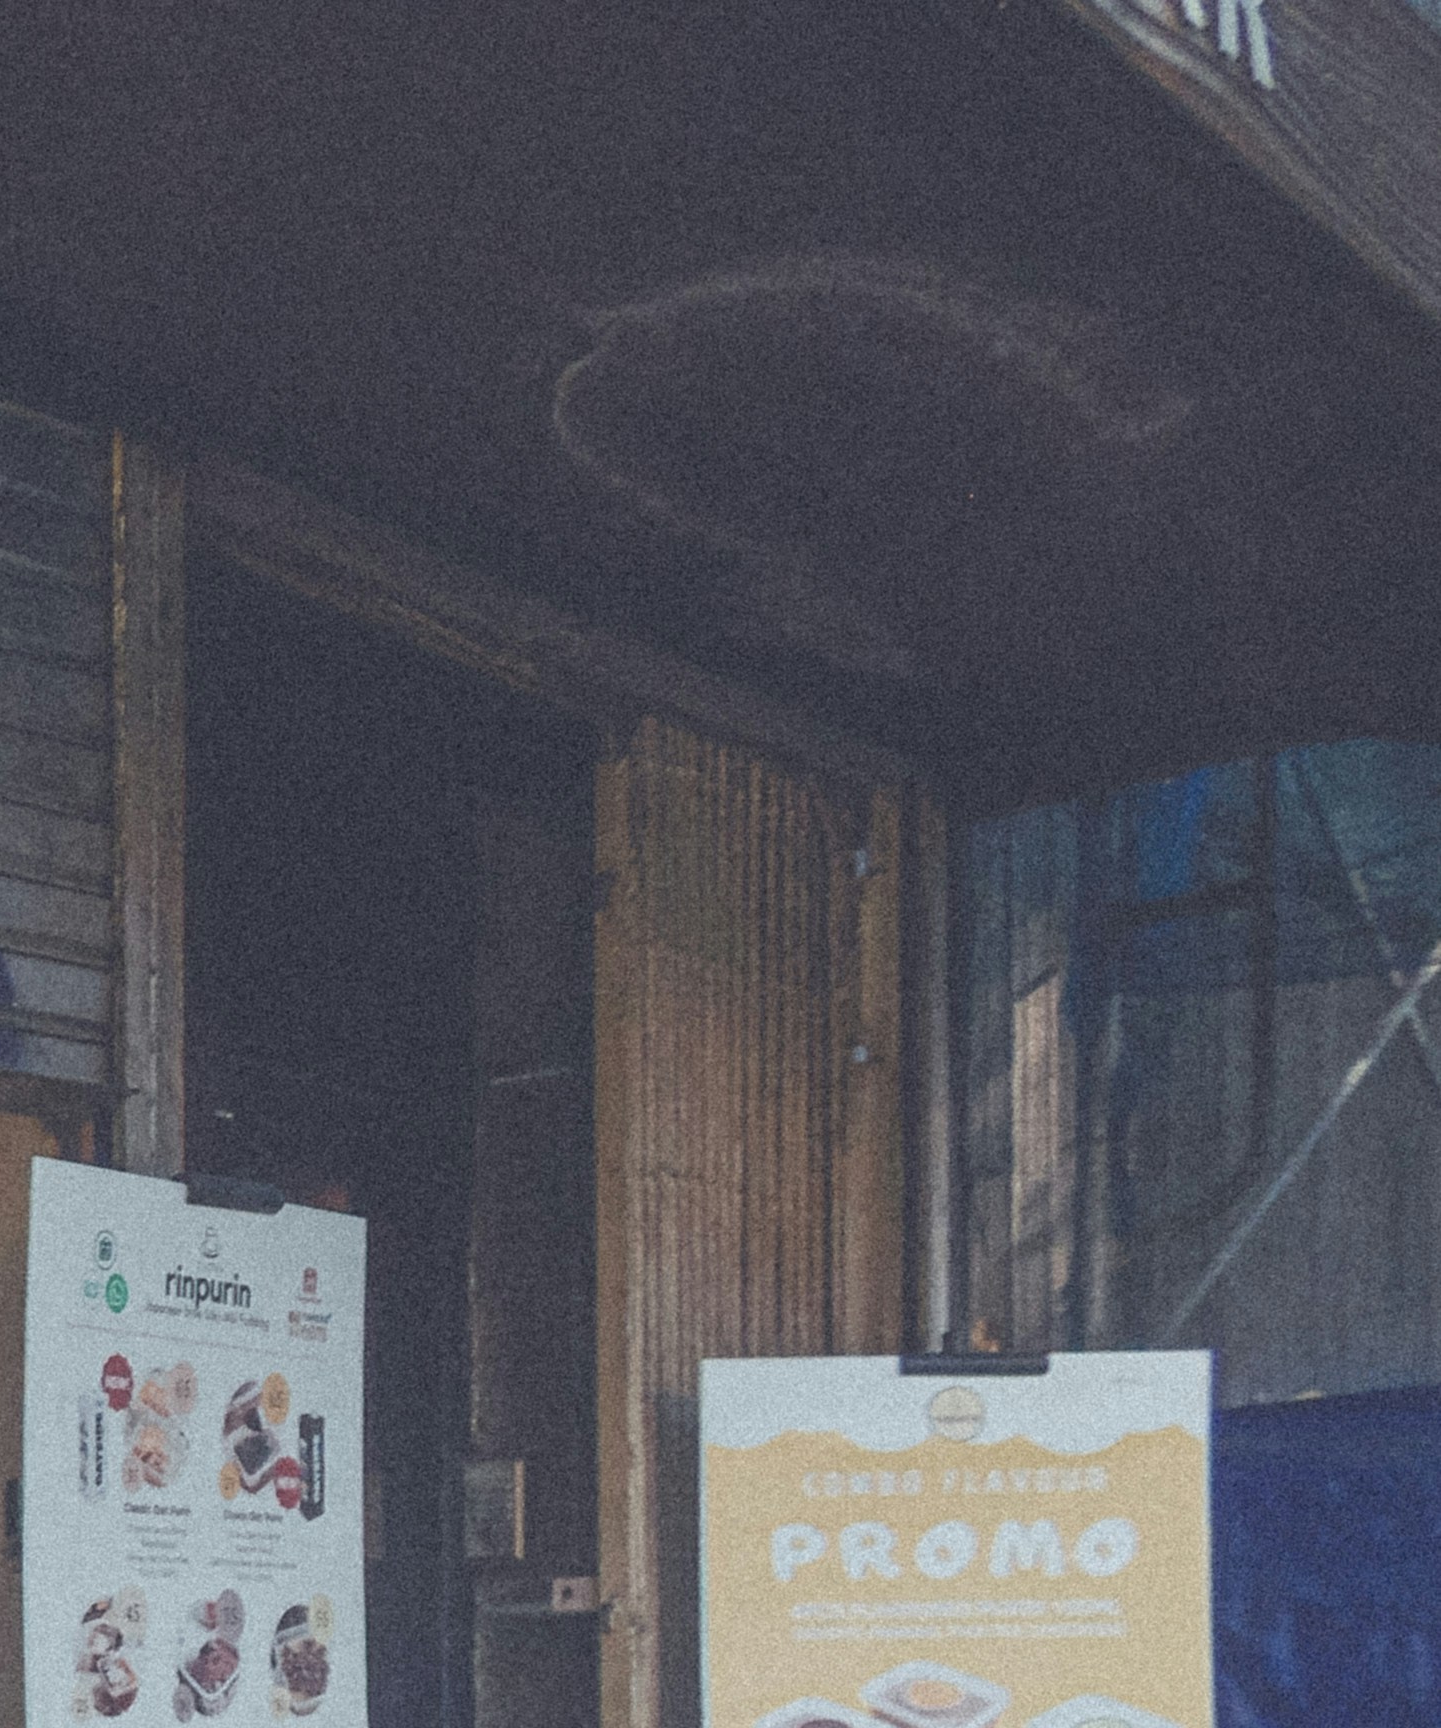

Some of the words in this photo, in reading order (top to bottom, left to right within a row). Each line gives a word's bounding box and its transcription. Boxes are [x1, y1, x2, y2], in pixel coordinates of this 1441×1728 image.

[166, 1265, 252, 1309] rinpurin
[801, 1467, 923, 1498] COMBO
[771, 1516, 1140, 1582] PROMO
